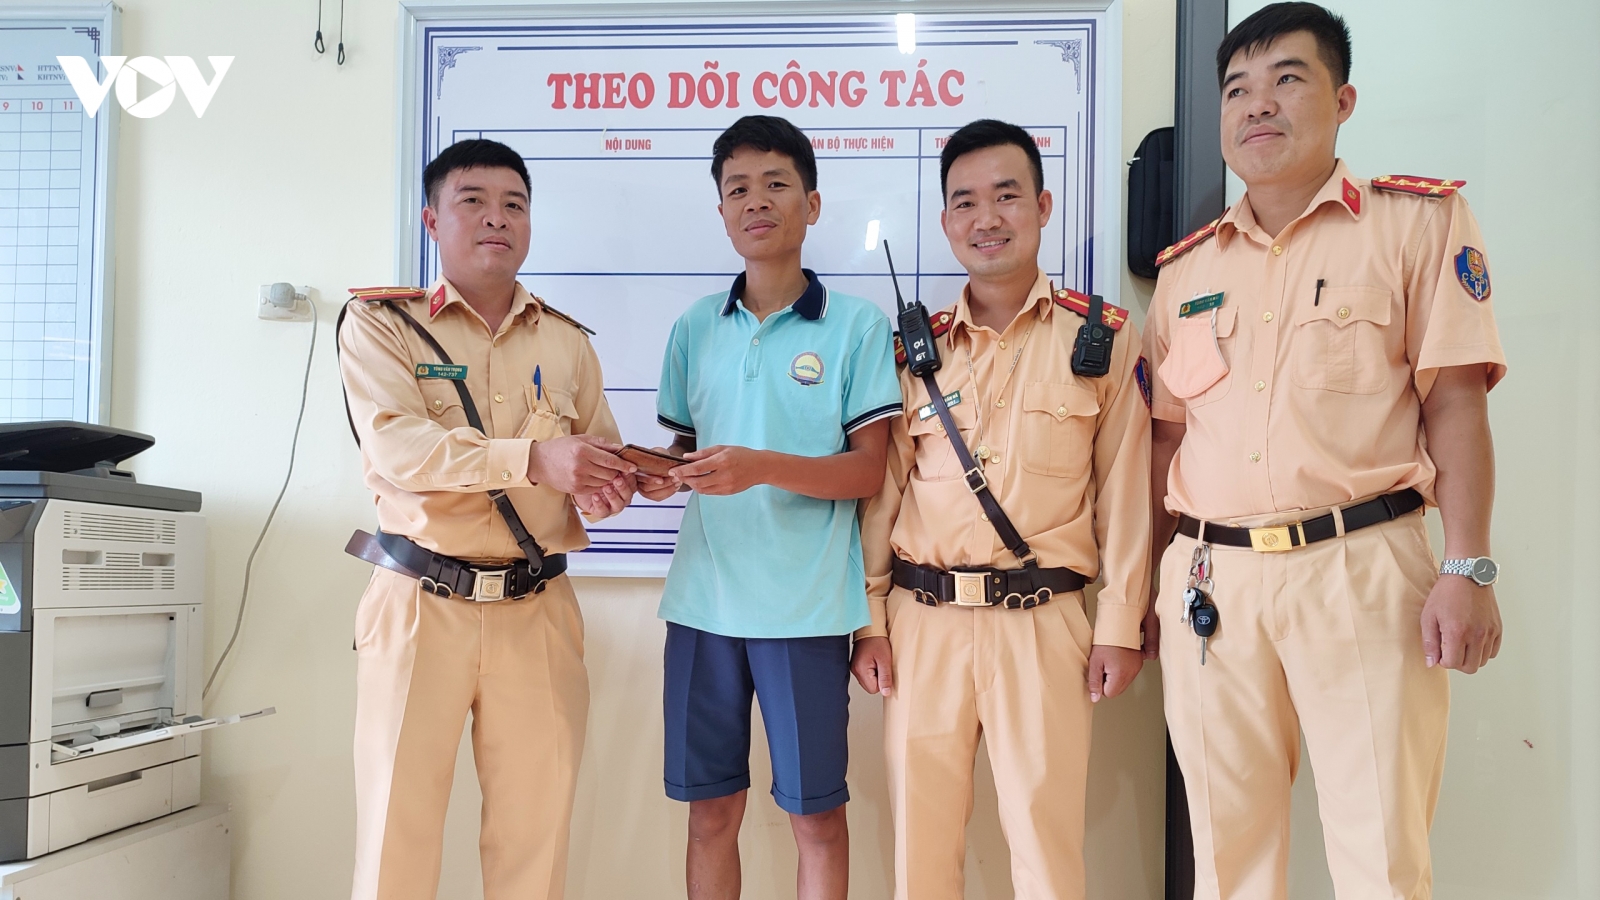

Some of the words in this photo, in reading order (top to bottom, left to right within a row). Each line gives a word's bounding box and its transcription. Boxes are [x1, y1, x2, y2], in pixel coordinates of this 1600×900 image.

[547, 72, 655, 110] THEO
[667, 60, 740, 109] DÕI
[752, 59, 868, 108] CÔNG
[879, 58, 965, 107] TÁC
[3, 102, 9, 111] 9
[32, 101, 43, 111] 10
[63, 101, 73, 111] 11
[605, 136, 622, 153] NỘI
[625, 139, 652, 151] DUNG
[810, 136, 825, 150] ÁN
[827, 136, 841, 152] BỘ
[843, 137, 868, 152] THỰC
[870, 136, 894, 152] HIỆN
